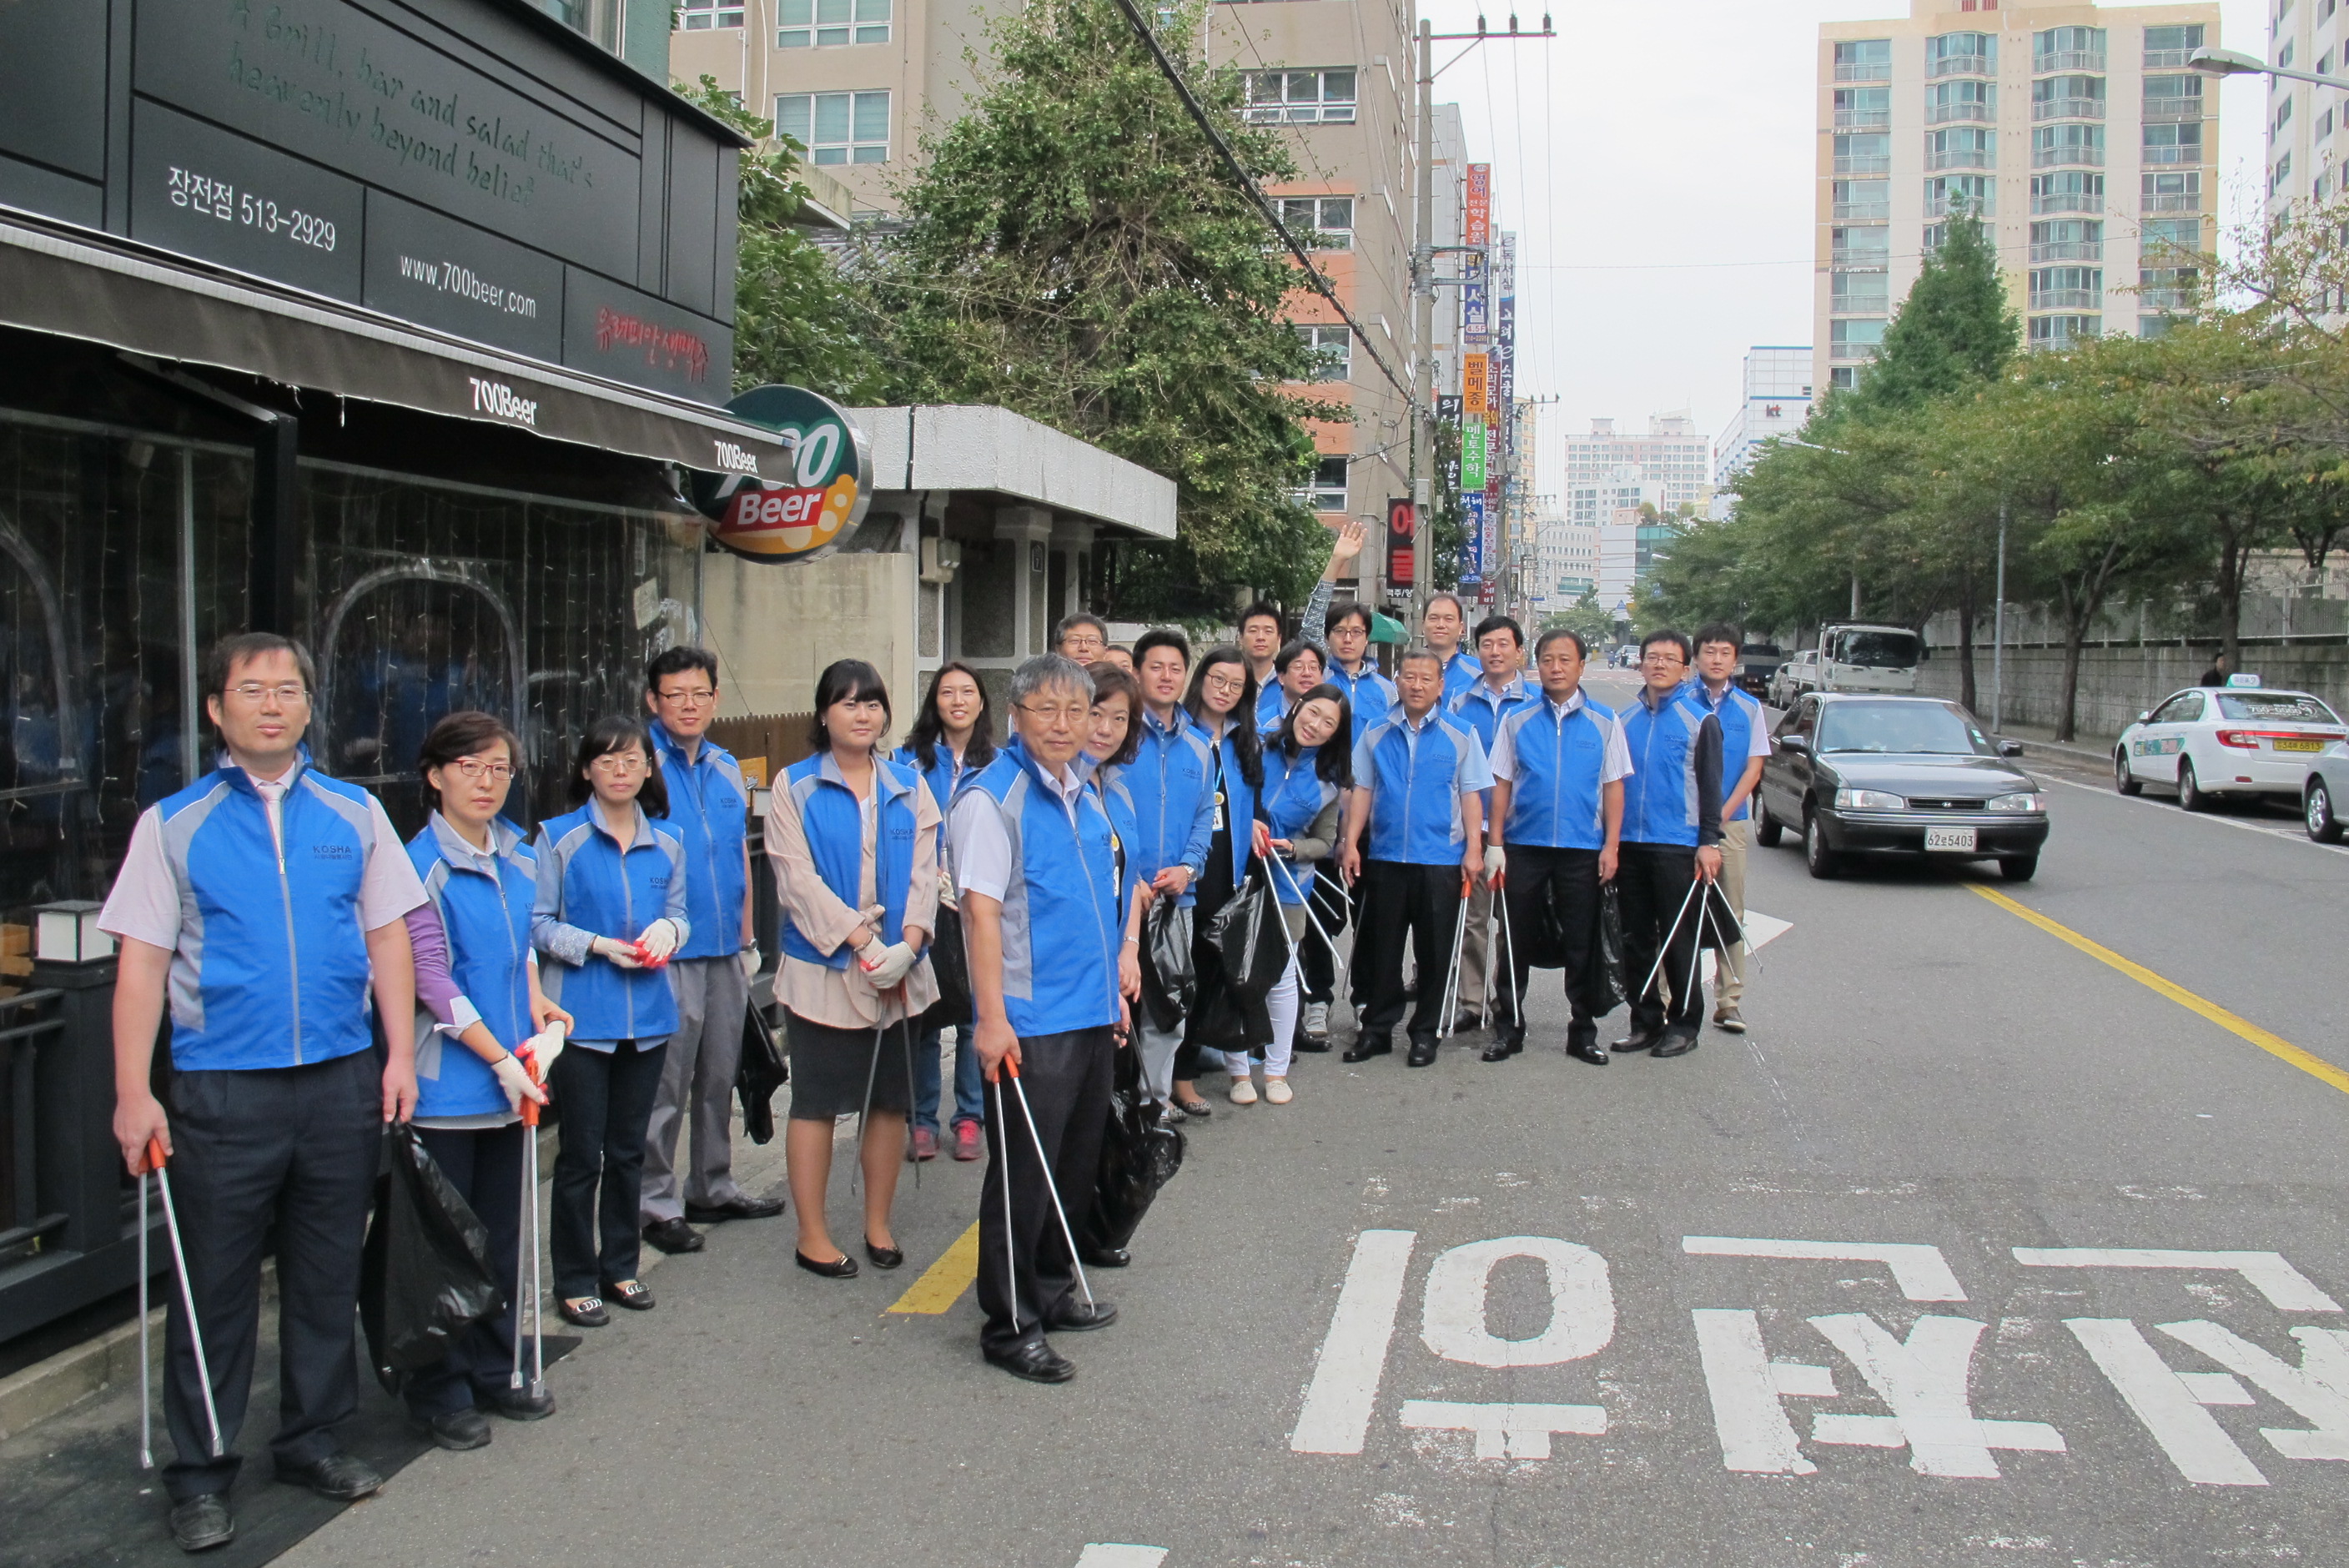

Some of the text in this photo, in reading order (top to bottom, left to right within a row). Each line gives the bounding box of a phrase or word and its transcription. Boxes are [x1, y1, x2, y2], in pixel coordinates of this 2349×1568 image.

[230, 41, 535, 206] heavenly beyond belief
[357, 48, 404, 99] bar
[411, 90, 458, 128] and
[467, 115, 530, 163] salad
[539, 142, 592, 189] that's
[1471, 173, 1486, 198] 영어
[169, 166, 335, 251] 장전점 513-2929
[400, 255, 536, 319] www.700beer.com
[469, 376, 537, 425] 700Beer
[1467, 361, 1484, 406] 벨메종
[1766, 404, 1782, 417] kt
[714, 440, 759, 474] 700Beer
[1465, 424, 1481, 478] 멘토수학
[737, 492, 822, 525] Beer
[1183, 767, 1201, 776] KOSHA
[313, 845, 352, 853] KOSHA
[1928, 834, 1974, 847] 62로5403
